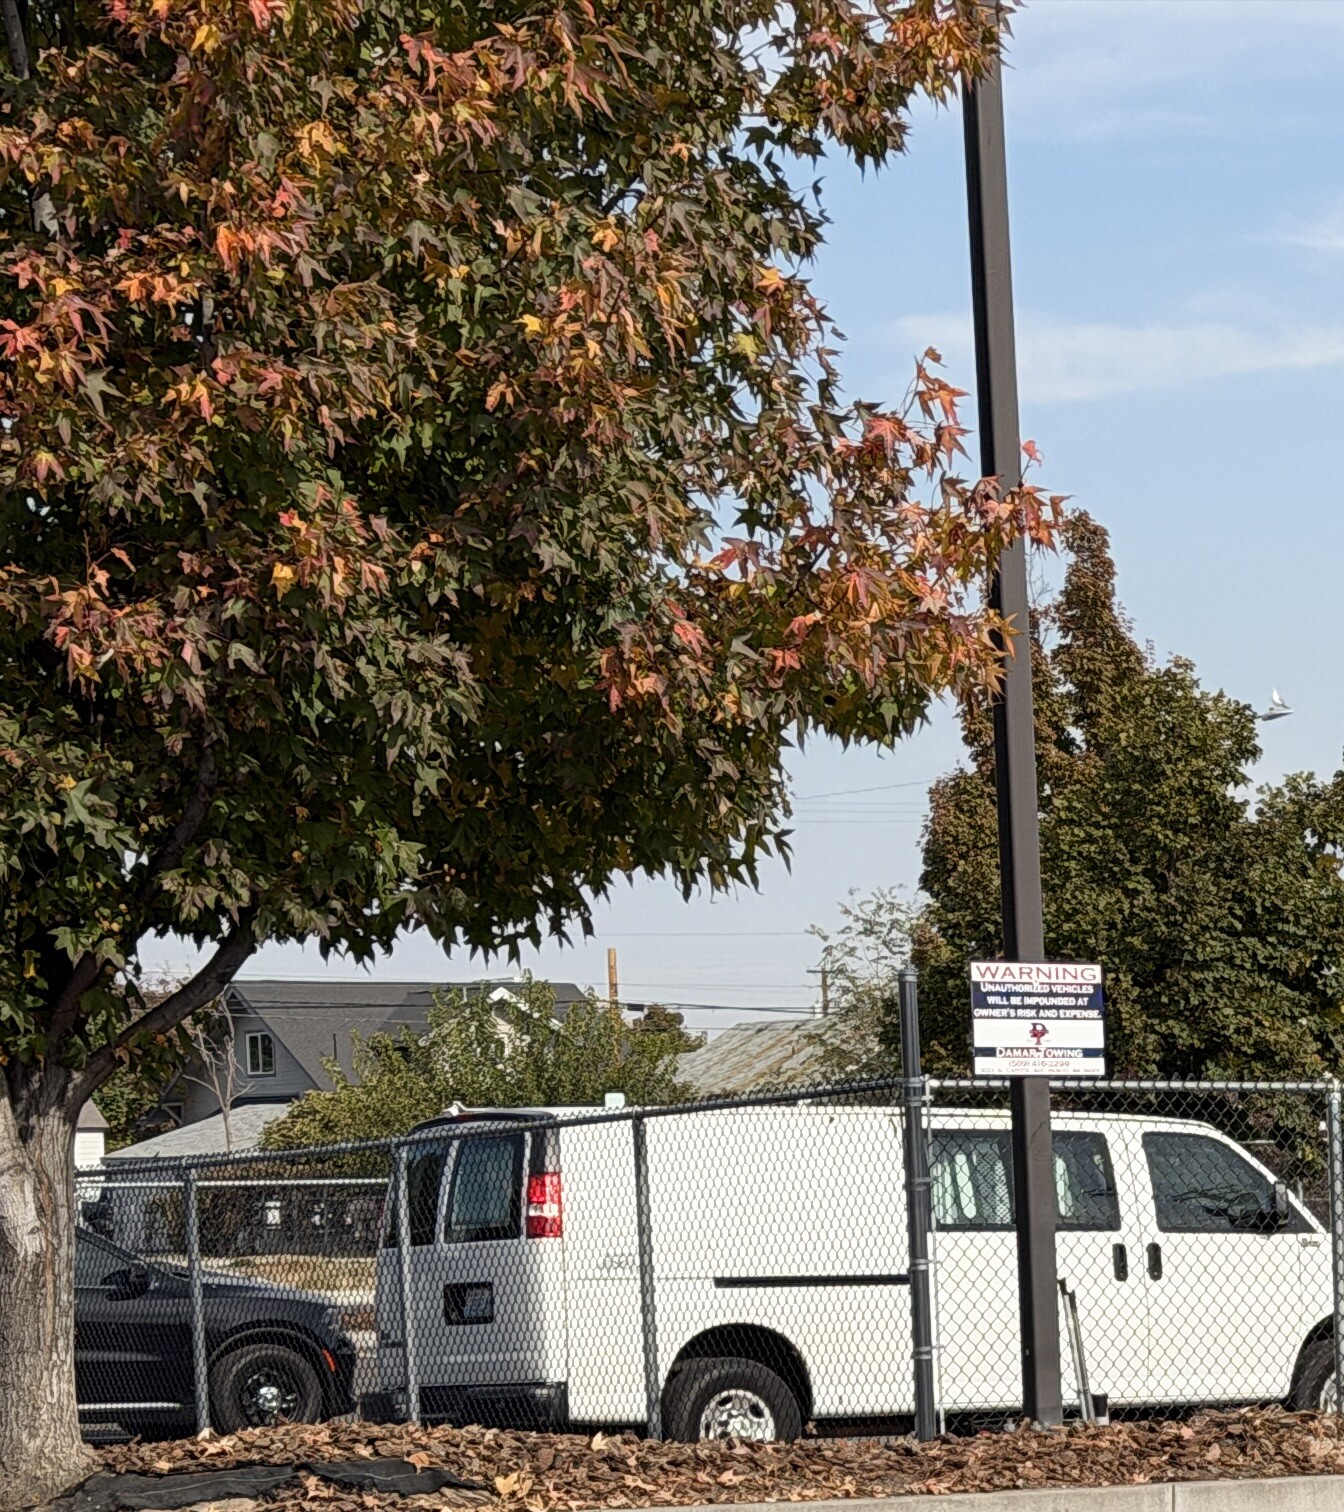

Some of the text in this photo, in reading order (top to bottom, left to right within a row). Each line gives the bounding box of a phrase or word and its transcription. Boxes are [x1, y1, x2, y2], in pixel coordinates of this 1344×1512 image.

[976, 965, 1097, 981] WARNING
[980, 982, 1094, 993] UNAUTHORIZED VEHICLES
[987, 995, 1089, 1006] WILL BE IMPOUNDED AT
[973, 1007, 1016, 1017] OWNER'S
[1017, 1008, 1037, 1018] RISK
[1037, 1009, 1058, 1018] AND
[1038, 1046, 1083, 1058] TOWING
